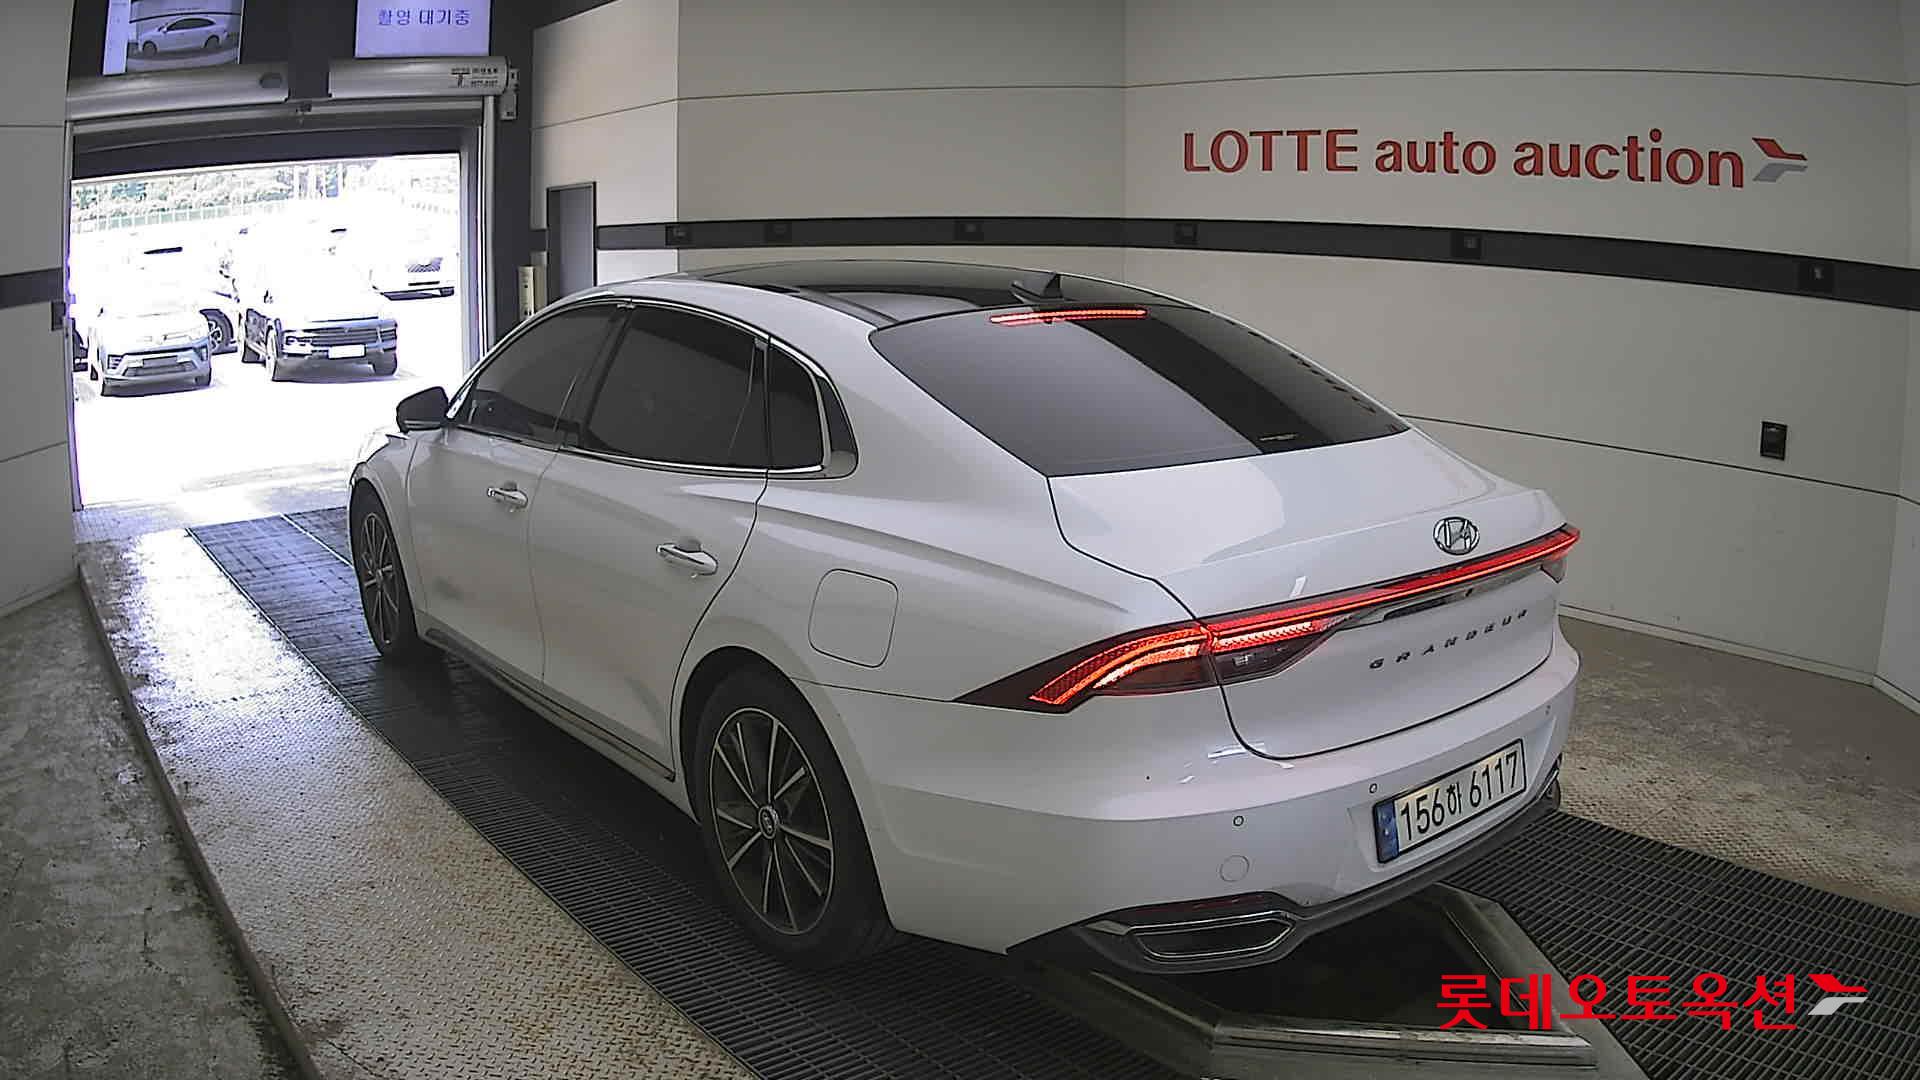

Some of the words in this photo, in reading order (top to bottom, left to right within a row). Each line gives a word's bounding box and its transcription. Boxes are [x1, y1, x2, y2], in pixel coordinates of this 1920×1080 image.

[418, 8, 471, 26] 대기중
[1183, 128, 1359, 173] LOTTE
[1375, 131, 1497, 175] auto
[1513, 127, 1744, 188] auction
[1368, 609, 1528, 669] GRANDEUR
[1400, 781, 1463, 841] 156하
[1468, 749, 1519, 808] 6117
